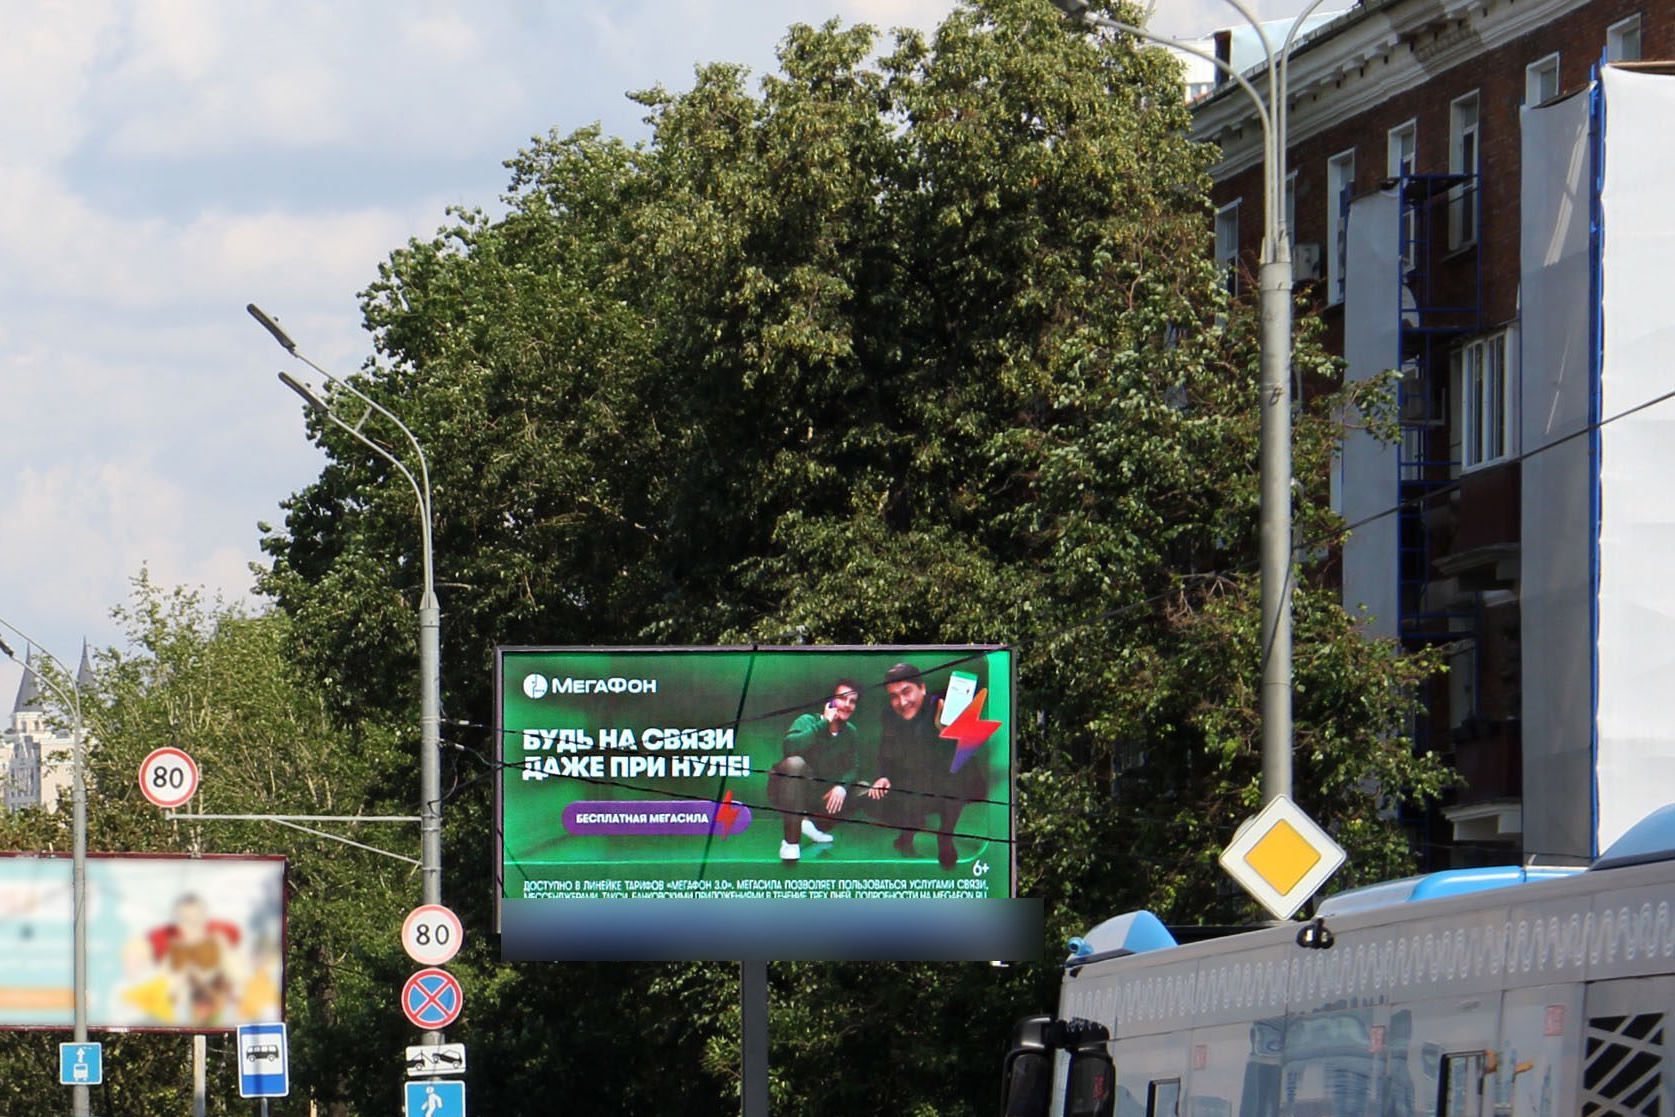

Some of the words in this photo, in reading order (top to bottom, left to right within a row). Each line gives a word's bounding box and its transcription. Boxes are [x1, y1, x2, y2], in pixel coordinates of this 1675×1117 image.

[523, 728, 594, 753] БУДЬ
[599, 728, 638, 751] НА
[642, 727, 735, 751] СВЯЗИ
[153, 766, 184, 789] 80
[522, 756, 605, 781] ДАЖЕ
[610, 756, 666, 777] ПРИ
[671, 756, 751, 778] НУЛЕ!
[576, 813, 648, 824] БЕСПЛАТНАЯ
[649, 813, 709, 824] МЕГАСИЛА
[973, 859, 990, 876] 6+
[523, 880, 573, 892] ДОСТУПНО
[575, 880, 581, 891] В
[583, 879, 622, 891] ЛИНЕЙКЕ
[625, 880, 664, 891] ТАРИФОВ
[667, 880, 713, 891] «МЕГАФОН
[737, 880, 782, 890] МЕГАСИЛА
[784, 880, 836, 890] ПОЗВОЛЯЕТ
[839, 880, 907, 890] ПОЛЬЗОВАТЬСЯ
[909, 880, 955, 890] УСЛУГАМИ
[416, 924, 449, 946] 80
